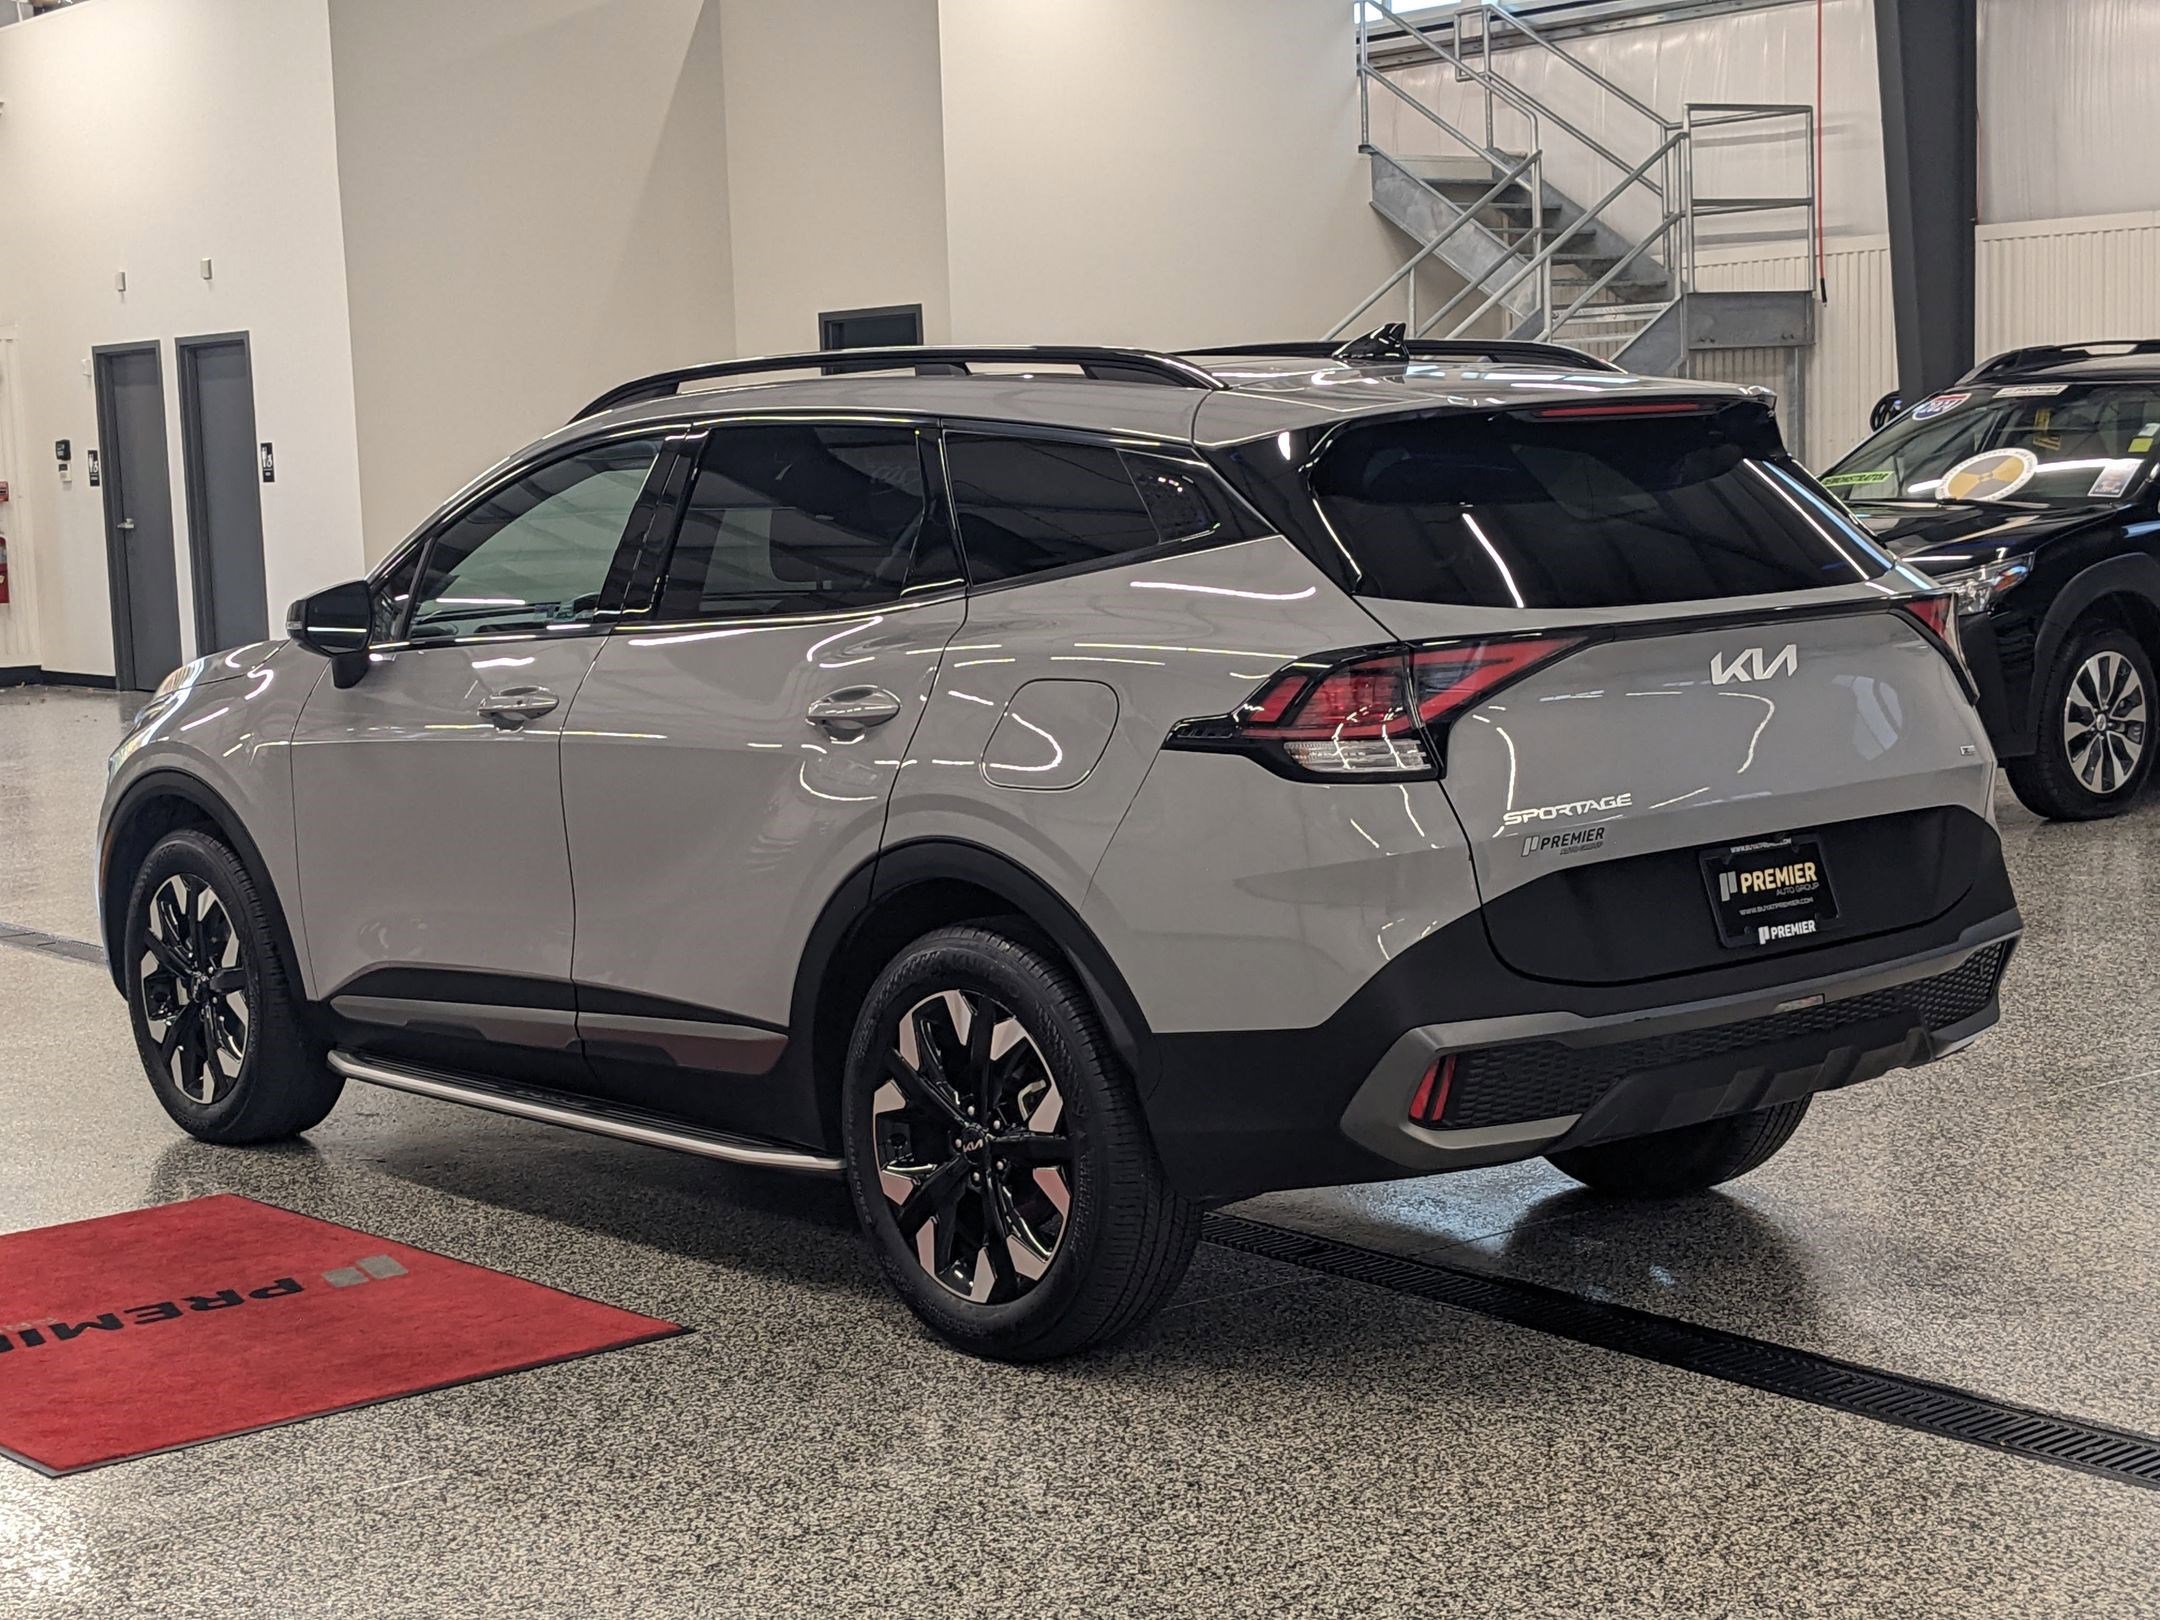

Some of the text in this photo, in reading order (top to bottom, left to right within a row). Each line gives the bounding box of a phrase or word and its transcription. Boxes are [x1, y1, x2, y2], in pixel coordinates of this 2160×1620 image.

[1710, 644, 1798, 686] KIA
[1503, 793, 1632, 825] SPORTAGE
[1540, 827, 1605, 850] PREMIER
[1740, 862, 1817, 894] PREMIER
[1776, 886, 1794, 896] AUTO
[1770, 920, 1816, 939] PREMIER
